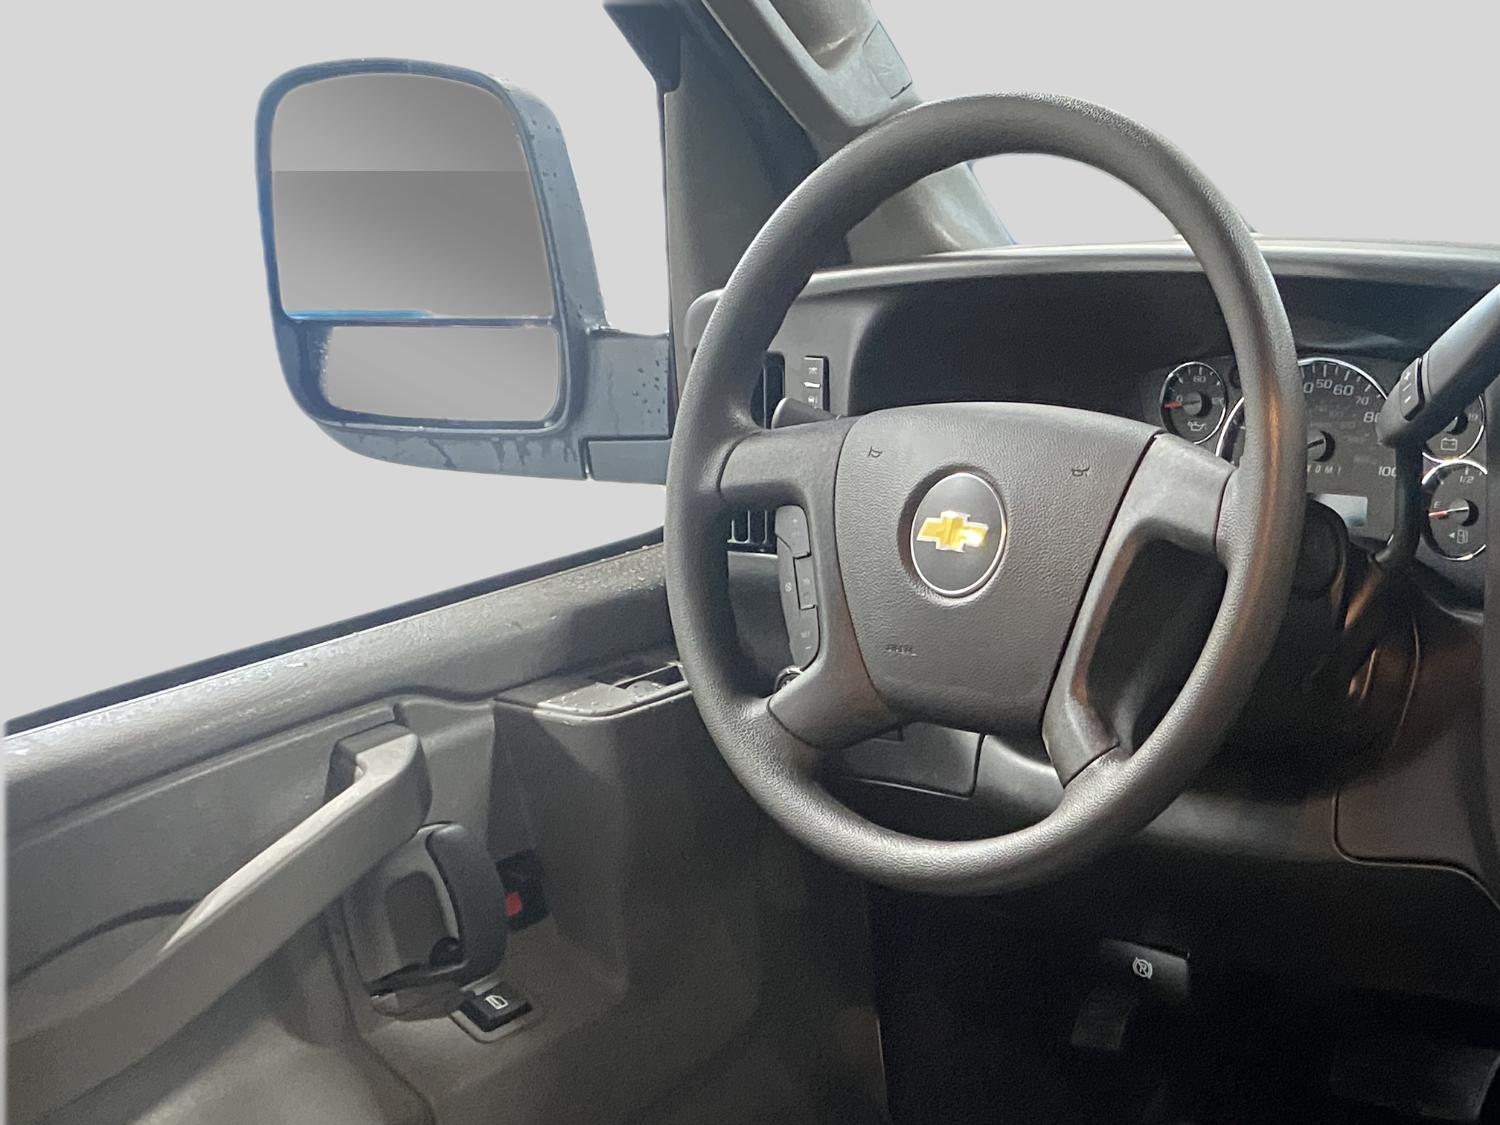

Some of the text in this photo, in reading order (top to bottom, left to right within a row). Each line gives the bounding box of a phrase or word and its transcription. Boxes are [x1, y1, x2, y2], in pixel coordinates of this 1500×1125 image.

[1303, 382, 1314, 394] 0
[1316, 379, 1333, 389] 50
[1332, 384, 1354, 396] 60
[1355, 396, 1369, 405] 70
[1459, 475, 1474, 484] 1/2
